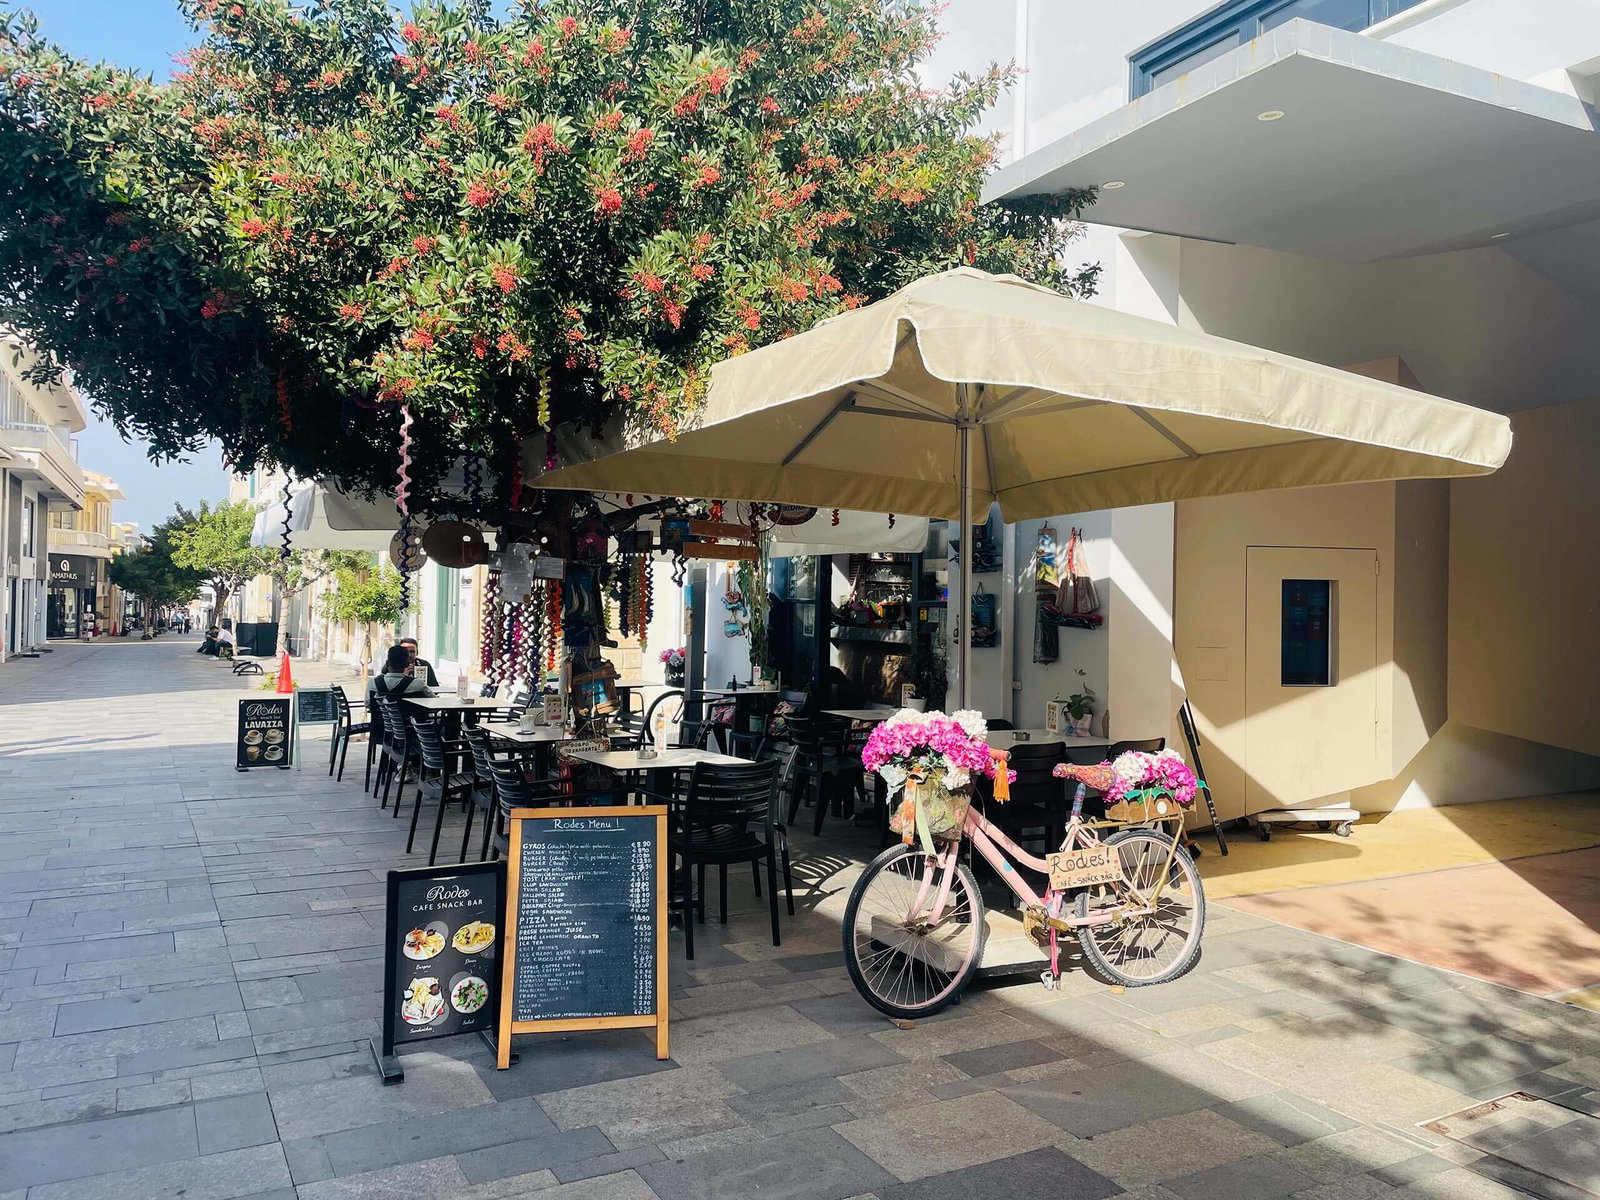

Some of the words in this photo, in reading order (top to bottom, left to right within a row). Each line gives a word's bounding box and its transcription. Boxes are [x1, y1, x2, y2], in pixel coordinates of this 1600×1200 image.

[52, 572, 78, 580] AMATHUS
[246, 702, 283, 716] Rodes
[245, 721, 283, 729] LAVAZZA
[553, 818, 585, 829] Rodes
[588, 819, 612, 829] Menu
[426, 885, 470, 901] Rodes
[412, 903, 433, 911] CAFE
[437, 900, 464, 910] SNACK
[467, 899, 483, 907] BAR
[519, 916, 546, 925] PIZZA
